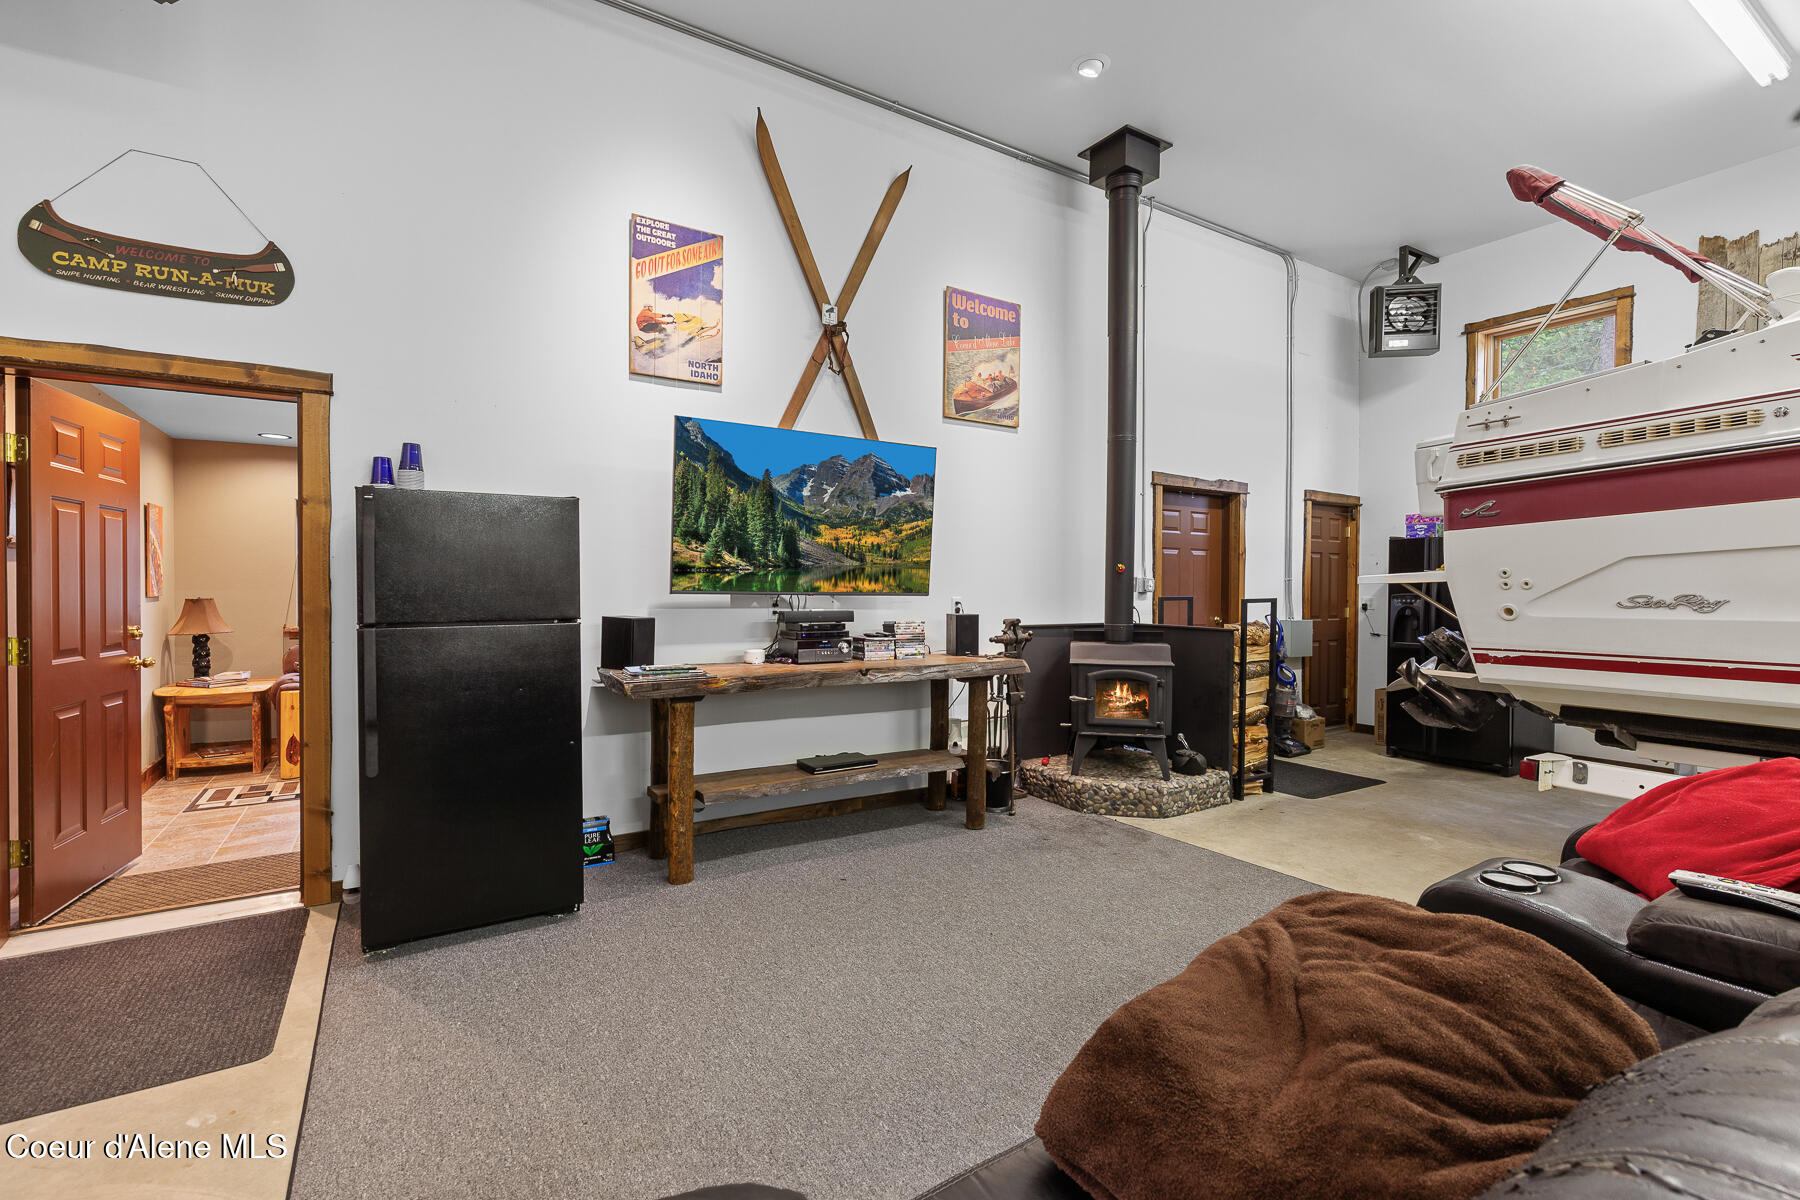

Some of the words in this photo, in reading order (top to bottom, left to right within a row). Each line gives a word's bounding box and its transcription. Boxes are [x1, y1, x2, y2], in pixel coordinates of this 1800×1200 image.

[636, 216, 670, 230] EXPLORE
[636, 225, 652, 235] THE
[652, 228, 677, 240] GREAT
[636, 233, 677, 248] OUTDOORS
[52, 251, 128, 273] CAMP
[115, 244, 187, 264] WELCOME
[192, 255, 210, 266] TO
[635, 260, 647, 279] GO
[648, 255, 666, 276] OUT
[666, 251, 681, 272] FOR
[682, 245, 703, 267] SOME
[55, 268, 81, 278] SNIPE
[82, 273, 121, 284] HUNTING
[133, 280, 157, 289] BEAR
[158, 284, 206, 296] WRESTLING
[215, 291, 245, 301] SKINNY
[244, 295, 276, 305] DIPPING
[952, 292, 1016, 323] Welcome
[952, 311, 969, 329] to
[688, 360, 719, 372] NORTH
[690, 369, 719, 381] IDAHO
[584, 836, 601, 844] LEAF
